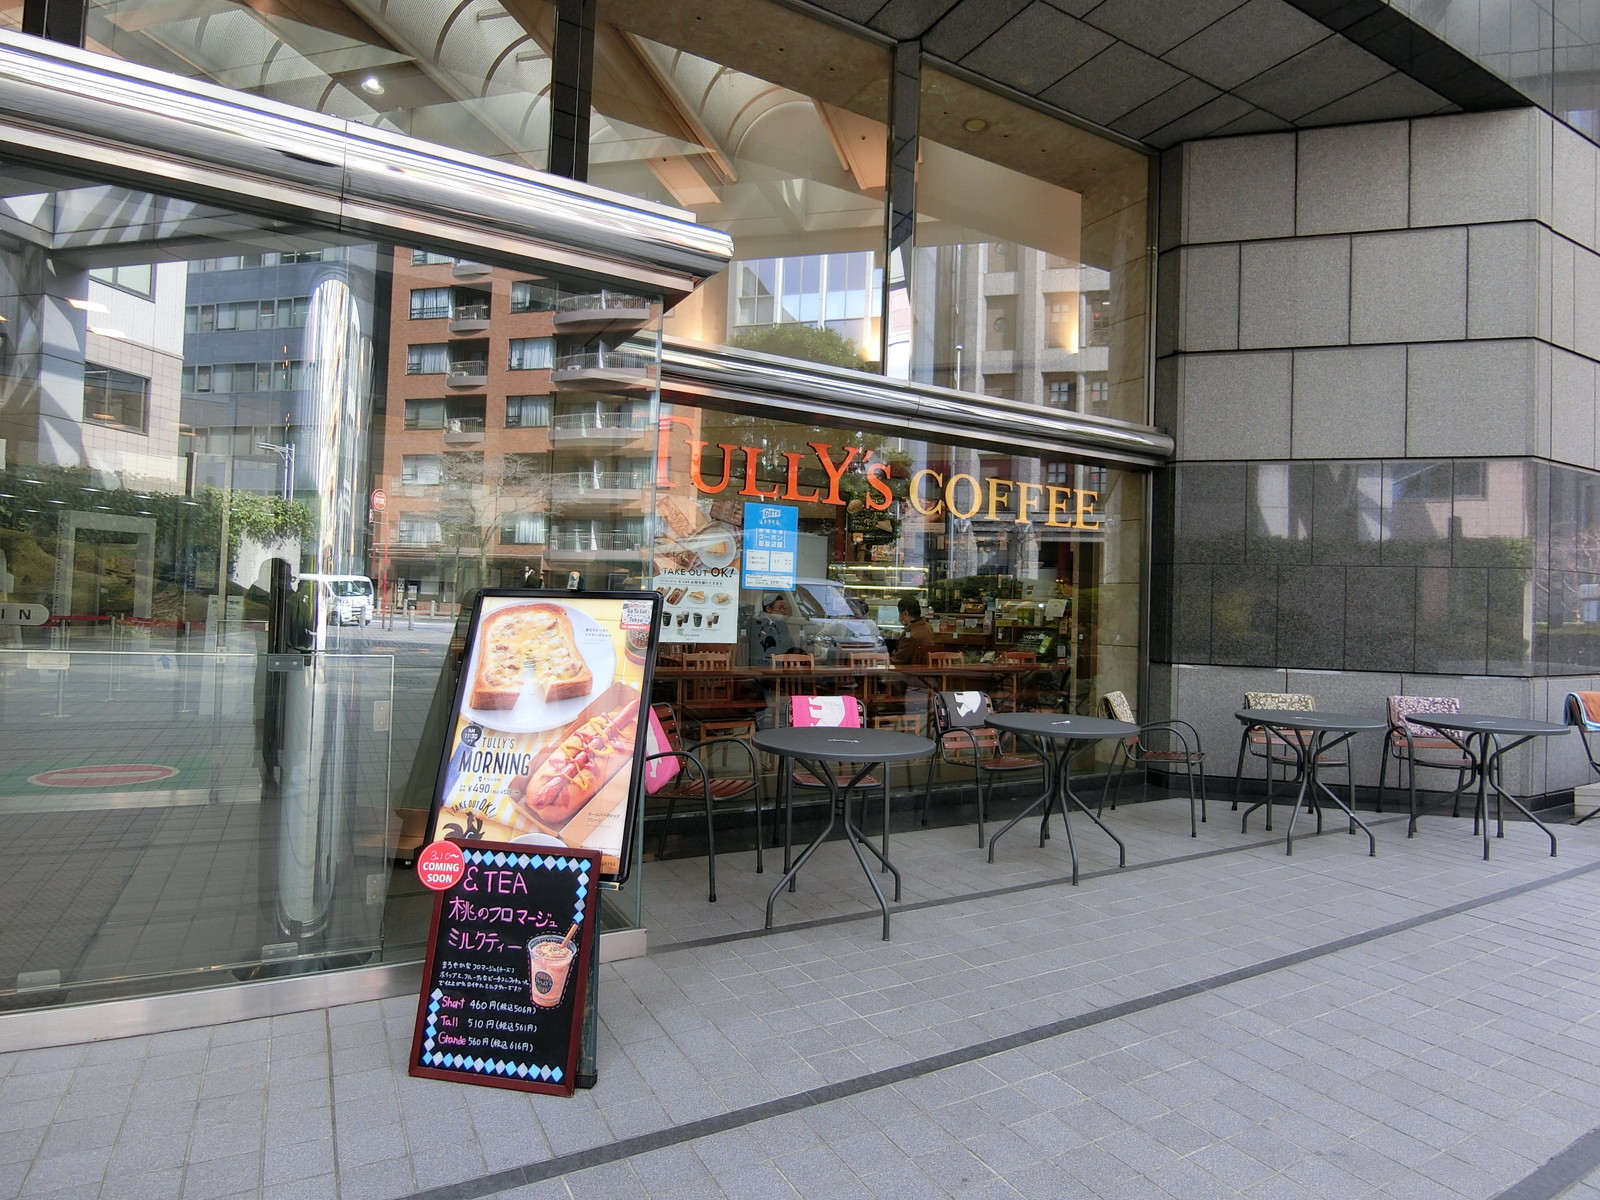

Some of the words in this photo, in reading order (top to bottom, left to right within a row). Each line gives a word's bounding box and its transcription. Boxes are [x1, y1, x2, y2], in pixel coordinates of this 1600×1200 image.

[652, 413, 894, 511] TULLY'S
[909, 468, 1101, 531] COFFEE
[662, 567, 686, 575] TAKE
[689, 568, 708, 577] OUT
[710, 567, 735, 578] OK!
[481, 737, 515, 750] TULLY'S
[458, 750, 531, 776] MORNING
[467, 783, 491, 794] ¥490
[451, 800, 467, 814] TAKE
[468, 799, 480, 809] OUT
[479, 798, 497, 817] OK!
[422, 861, 460, 872] COMING
[427, 873, 453, 883] SOON
[483, 870, 528, 894] TEA
[448, 896, 558, 928] 桃のフロマージュ
[448, 927, 523, 953] ミルクティー
[441, 995, 466, 1009] Short
[440, 1015, 459, 1027] Tall
[437, 1031, 467, 1046] Grande
